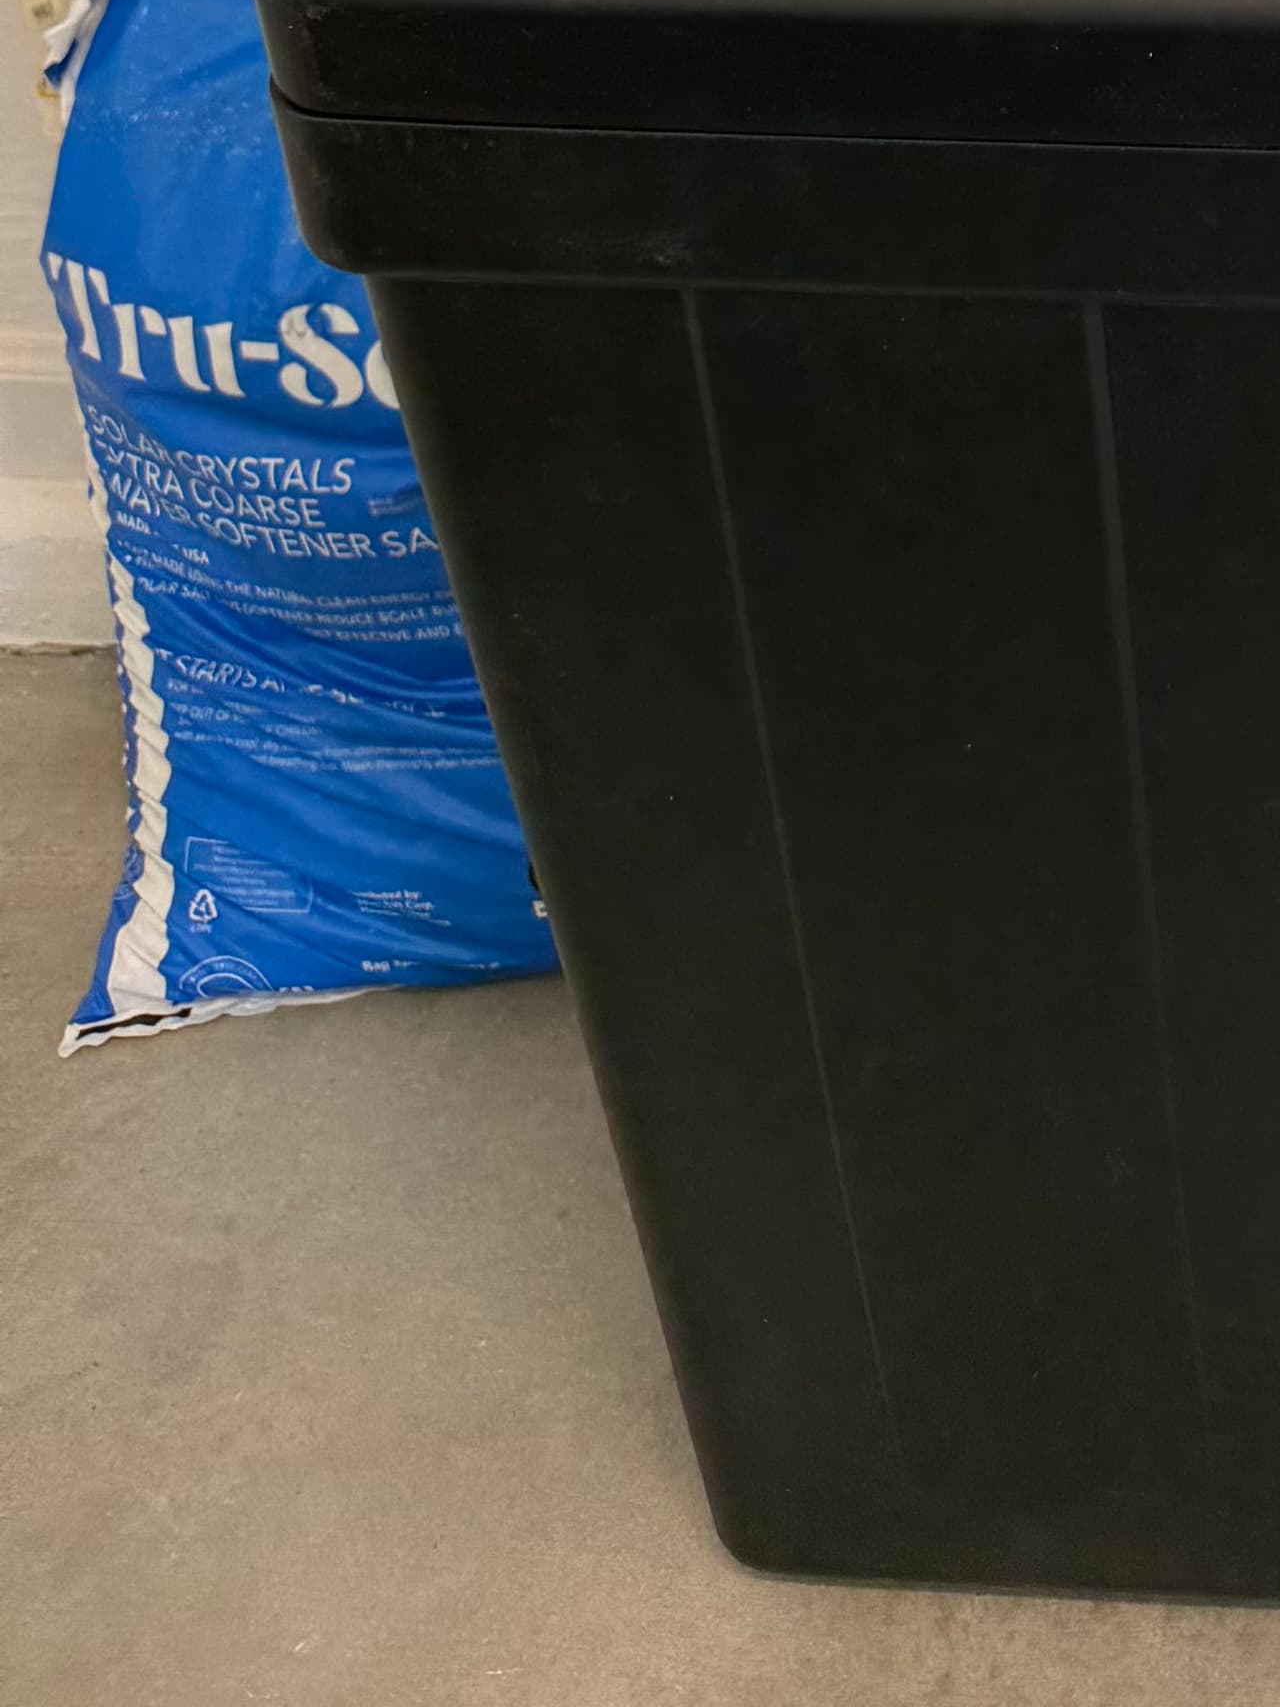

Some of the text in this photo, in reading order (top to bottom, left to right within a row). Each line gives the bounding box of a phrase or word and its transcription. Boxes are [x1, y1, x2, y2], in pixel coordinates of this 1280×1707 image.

[176, 450, 355, 494] CRYSTALS
[188, 477, 325, 528] COARSE
[199, 512, 377, 559] SOFTENER
[381, 527, 439, 557] SA
